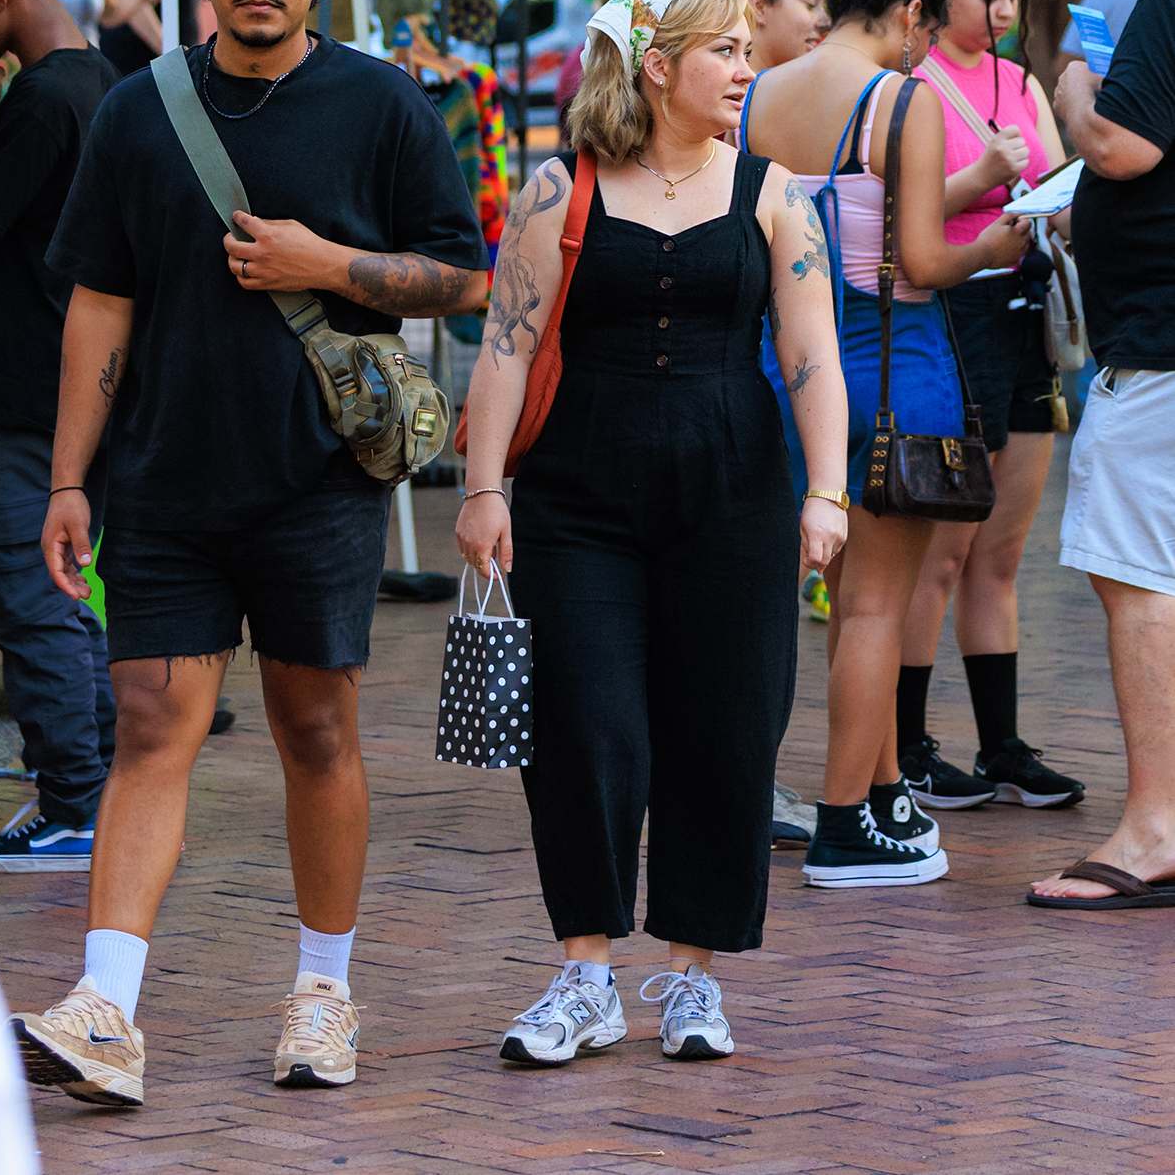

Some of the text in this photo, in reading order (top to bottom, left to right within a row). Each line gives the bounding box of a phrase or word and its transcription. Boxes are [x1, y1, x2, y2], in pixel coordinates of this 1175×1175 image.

[99, 351, 118, 398] Ohana
[316, 982, 333, 992] NIKE
[569, 1002, 592, 1025] N
